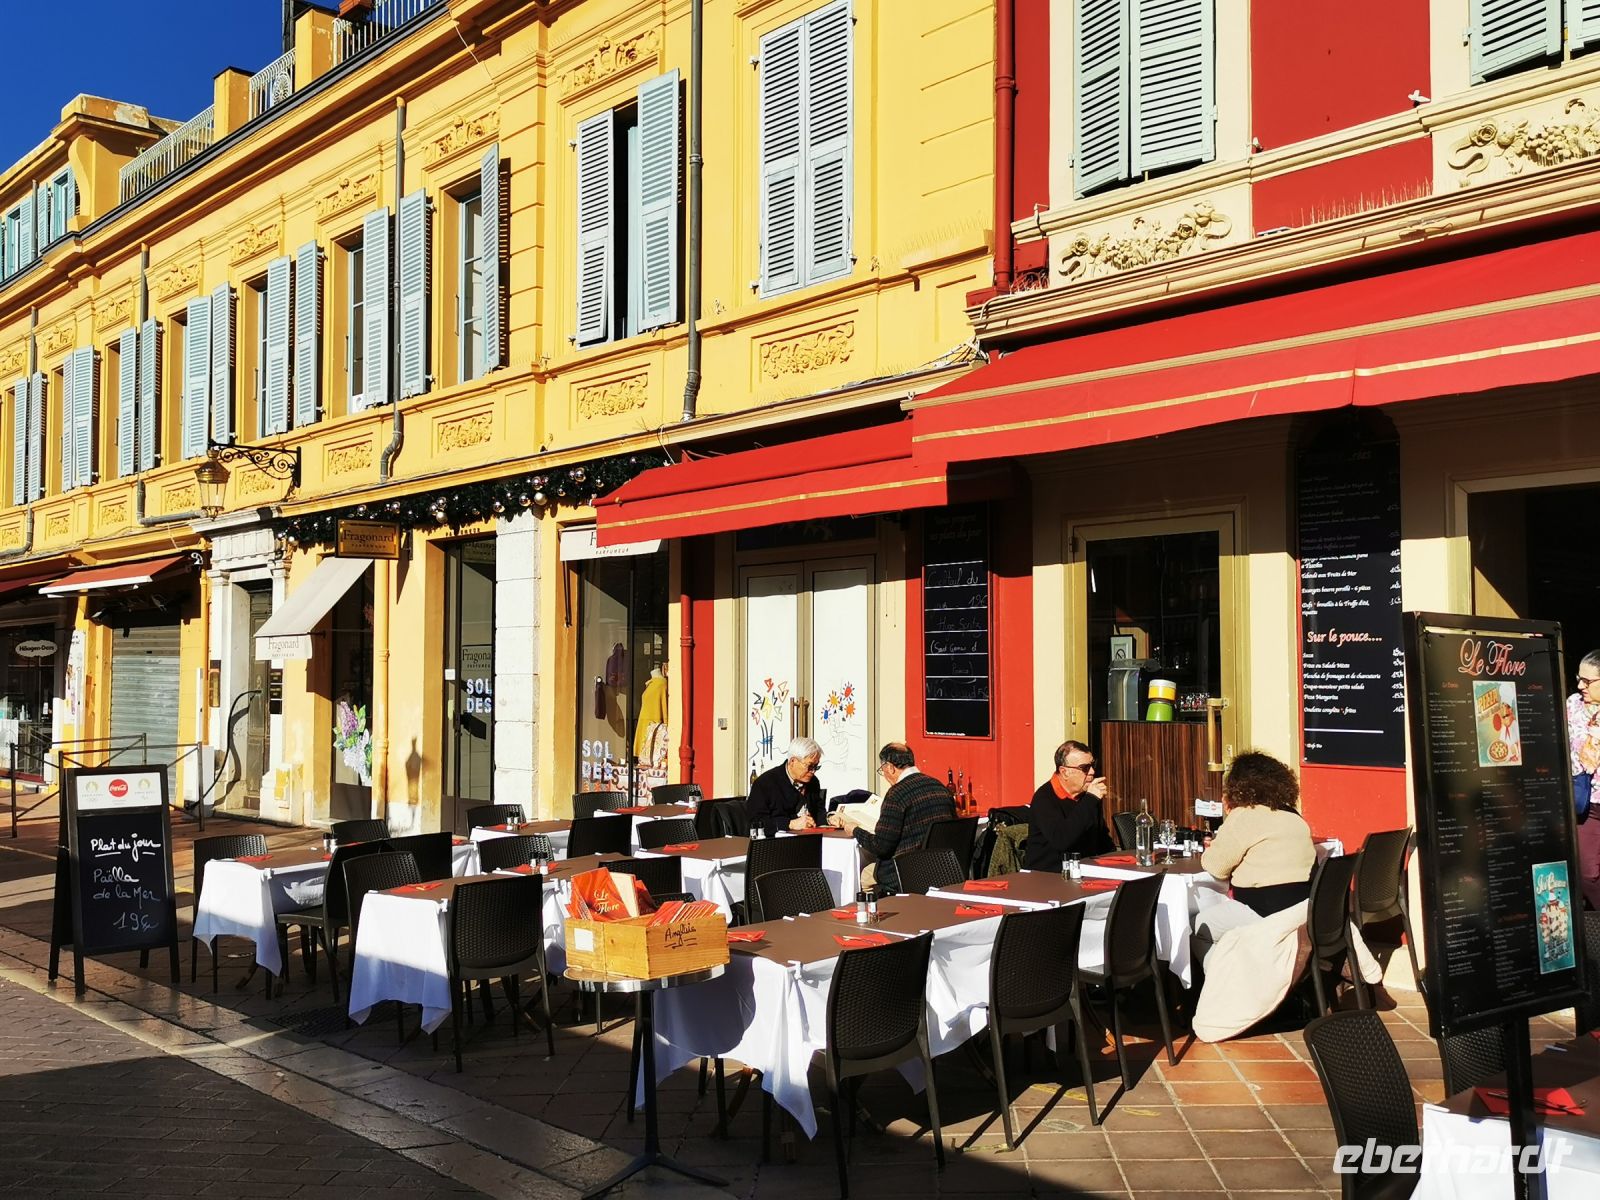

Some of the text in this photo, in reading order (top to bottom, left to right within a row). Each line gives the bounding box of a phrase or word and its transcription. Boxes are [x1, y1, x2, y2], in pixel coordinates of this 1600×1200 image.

[343, 529, 394, 543] Fragonard
[596, 547, 629, 555] PARFUMEUR
[1306, 631, 1327, 643] Sur
[1328, 628, 1338, 643] le
[269, 637, 299, 652] Fragonard
[1458, 638, 1526, 677] Le Flore
[466, 678, 492, 695] SOL
[466, 697, 492, 713] DES
[1478, 687, 1500, 711] PIZZA
[582, 740, 613, 759] SOL
[90, 833, 161, 862] Plat du jour
[93, 866, 139, 883] Paëlla
[93, 884, 161, 909] de la Mer
[593, 890, 609, 900] Le
[594, 901, 620, 914] Flore
